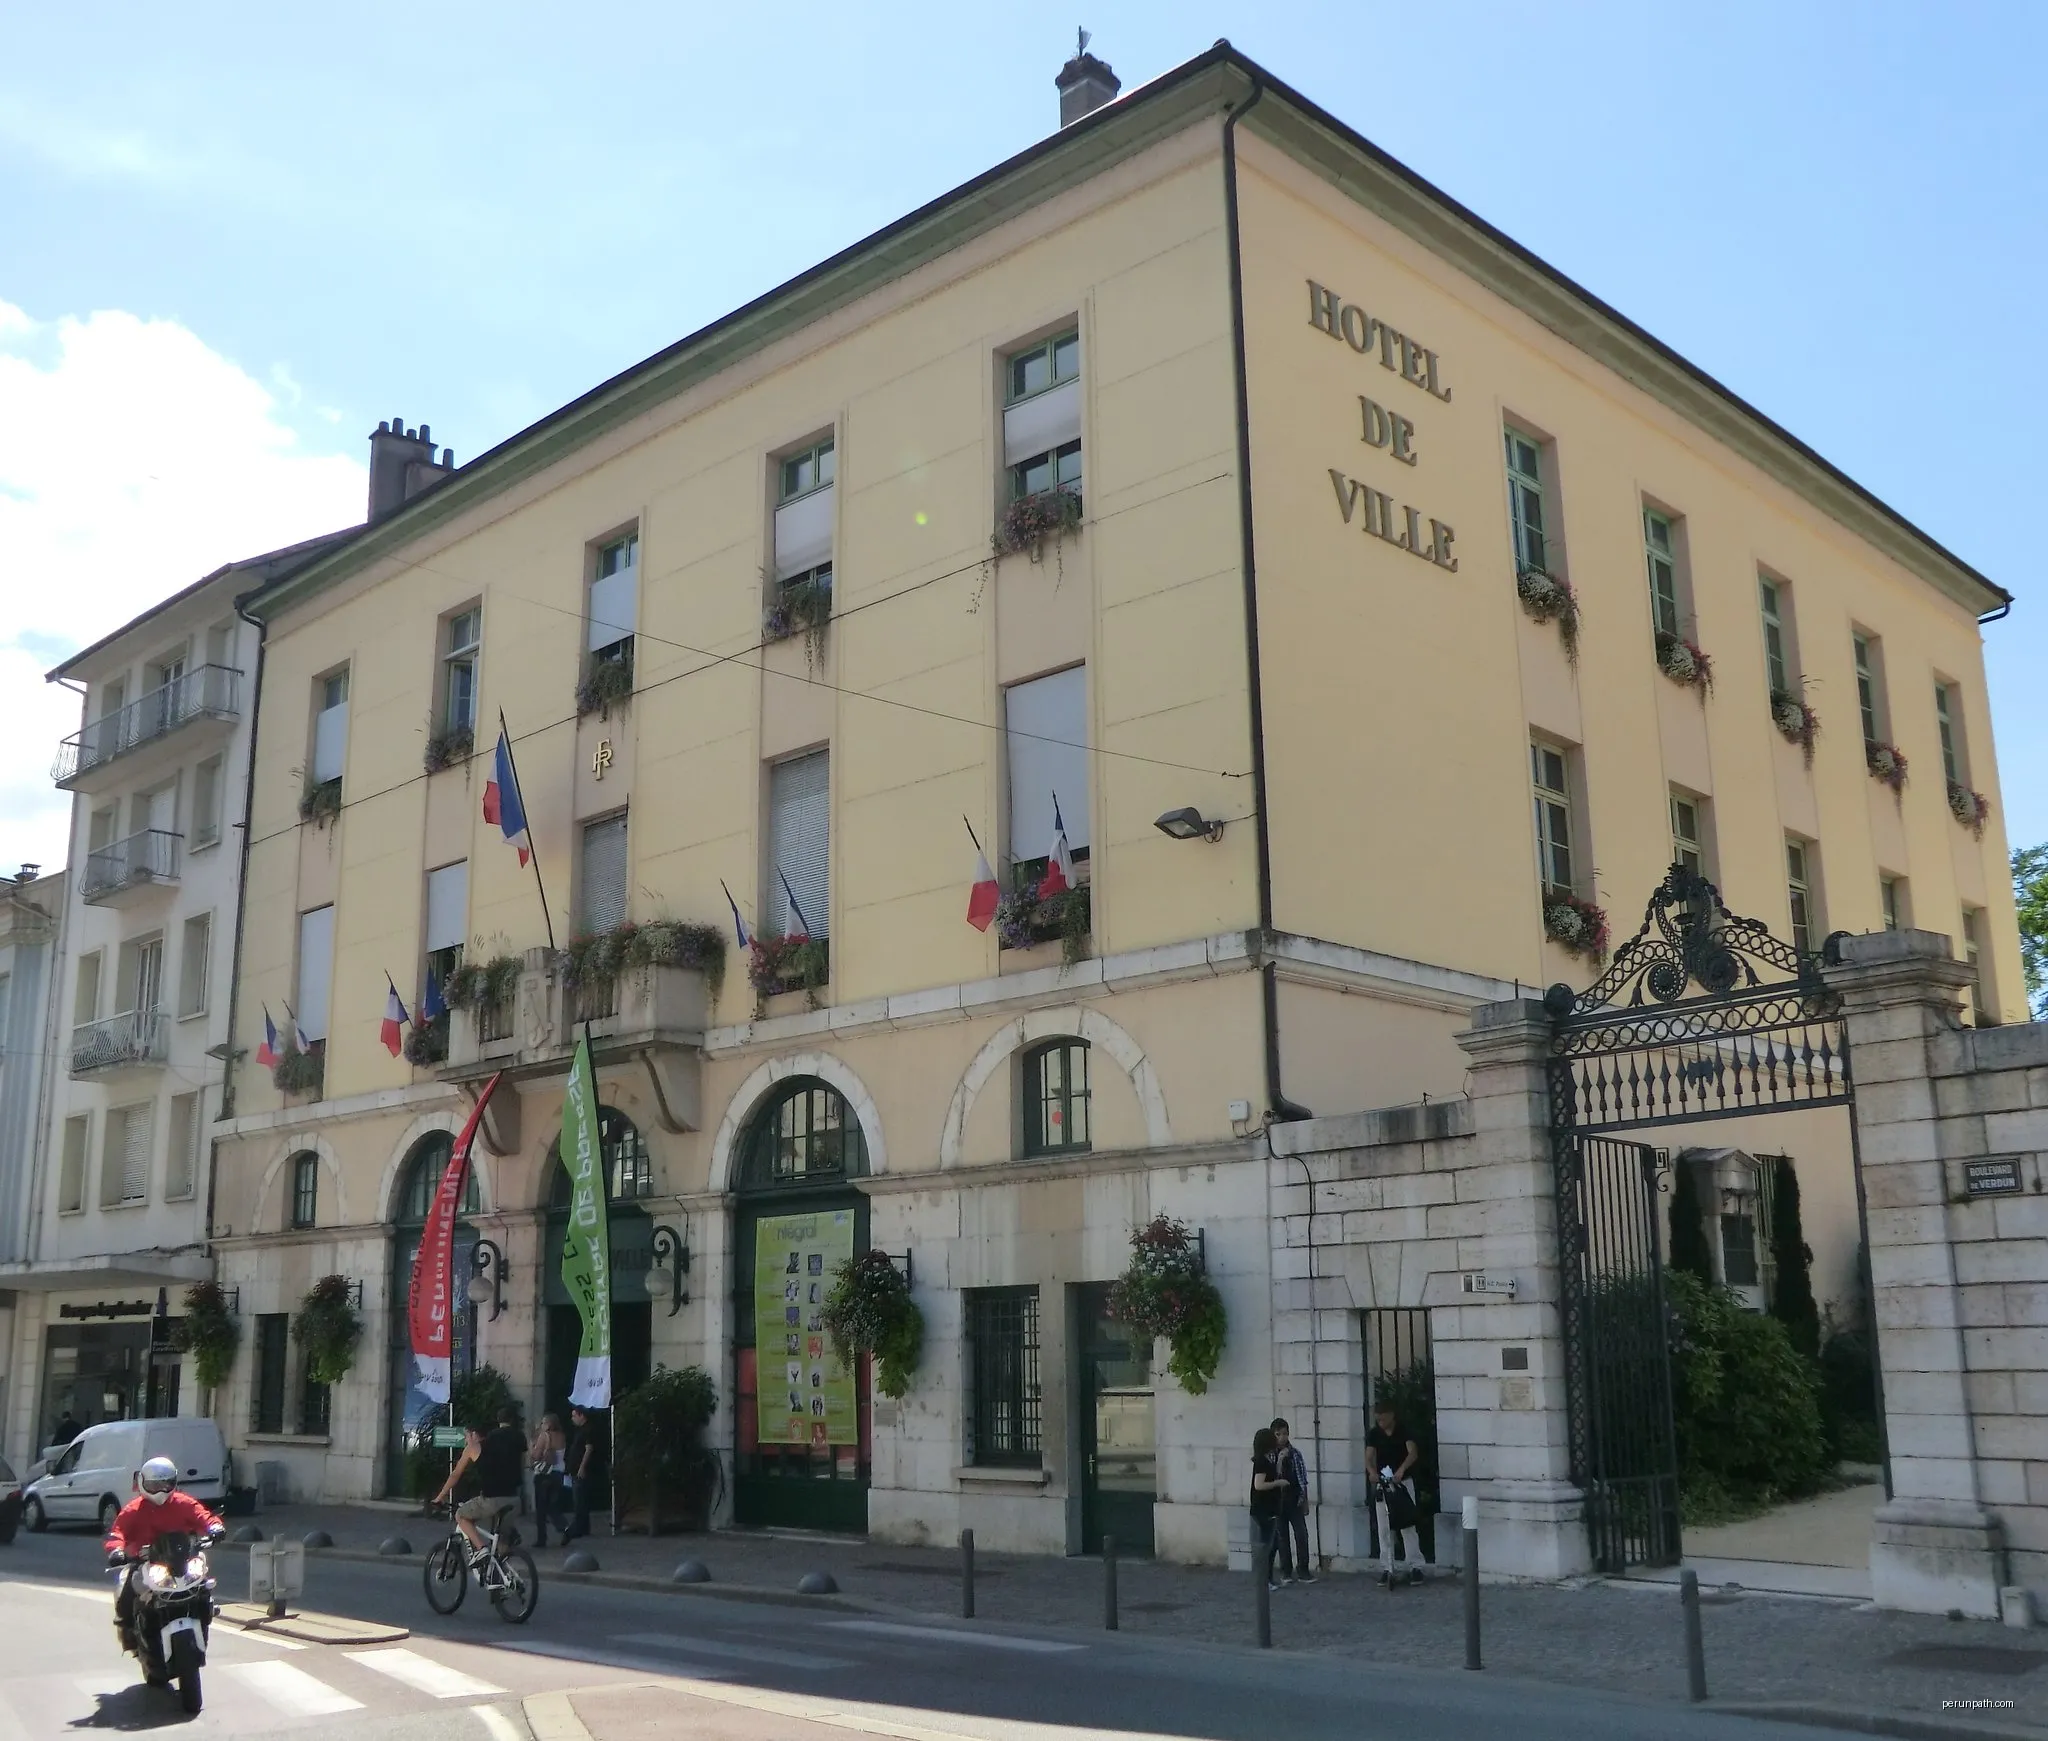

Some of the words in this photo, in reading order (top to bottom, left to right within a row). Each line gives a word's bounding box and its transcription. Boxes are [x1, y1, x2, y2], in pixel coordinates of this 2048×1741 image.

[1305, 279, 1451, 403] HOTEL
[1358, 394, 1417, 467] DE
[1328, 468, 1458, 573] VILLE
[1969, 1164, 2012, 1177] BOULEVARD
[1970, 1182, 1979, 1190] DE
[1979, 1177, 2015, 1188] VERDUN
